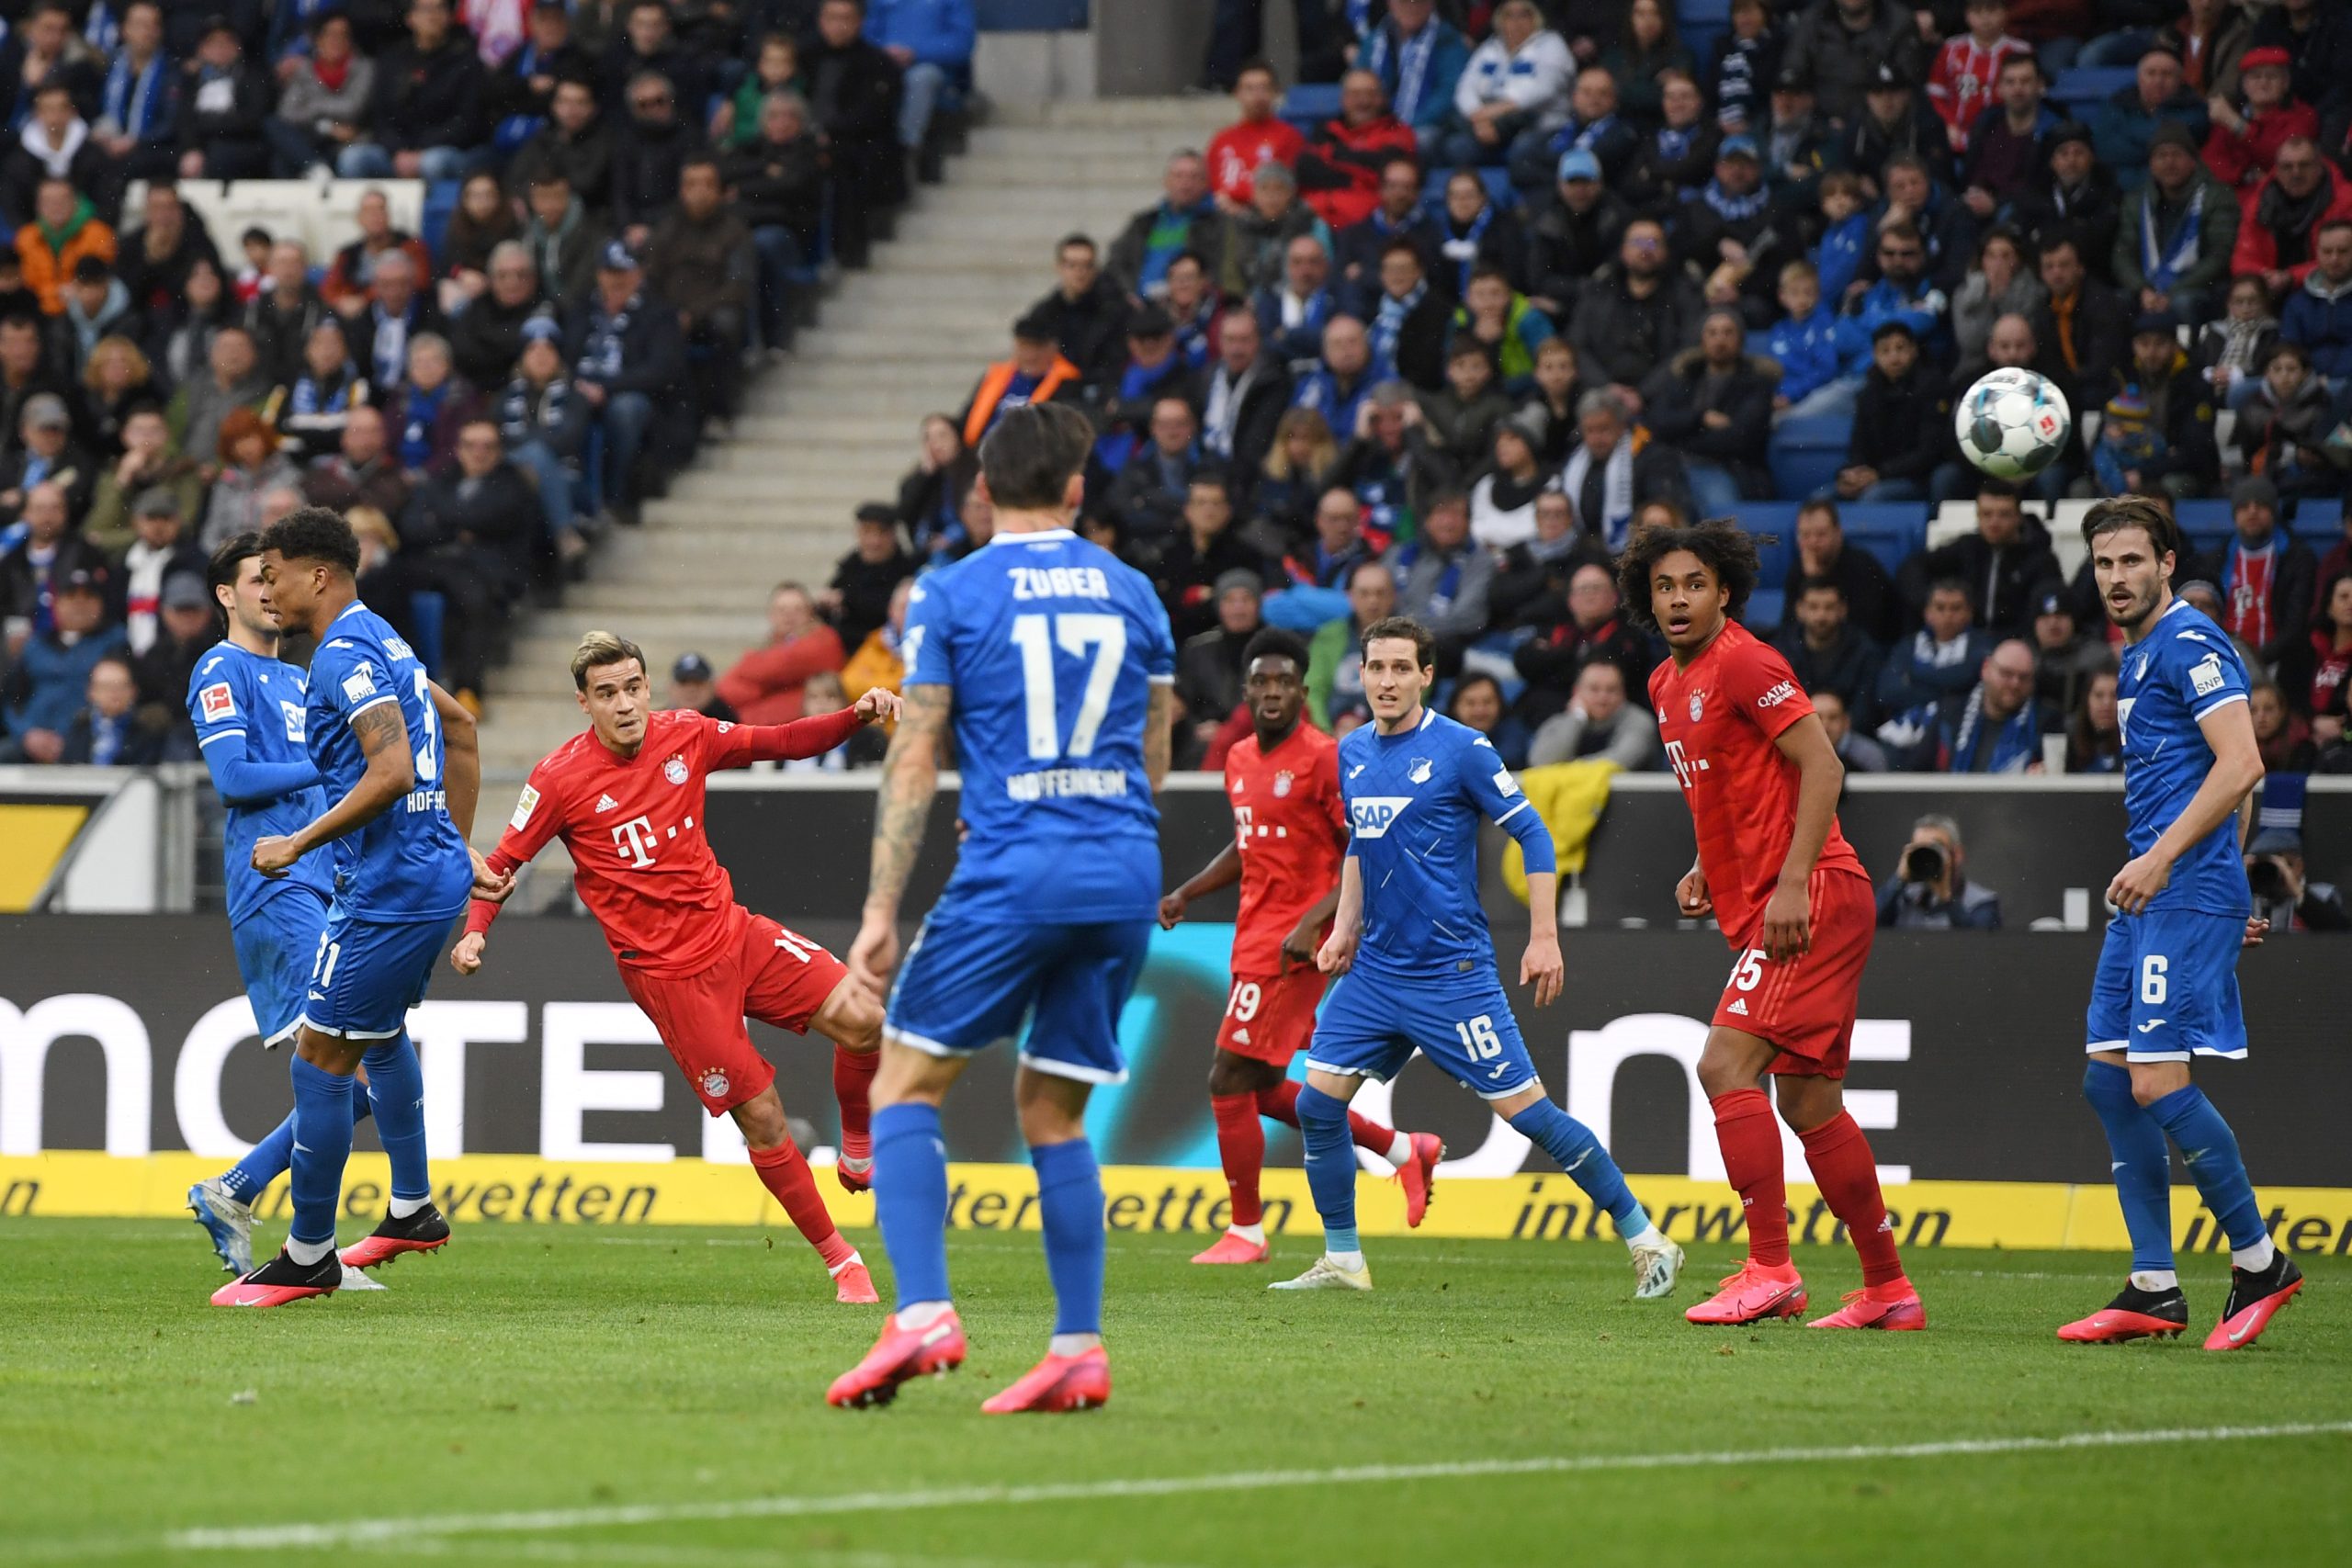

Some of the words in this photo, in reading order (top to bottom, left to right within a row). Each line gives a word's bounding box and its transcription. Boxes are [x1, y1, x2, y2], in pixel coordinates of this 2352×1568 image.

[1007, 567, 1110, 600] ZUBER
[352, 685, 373, 702] SNP
[1010, 613, 1126, 759] 17
[1758, 680, 1792, 707] QATAR
[2197, 676, 2222, 694] SNP
[1353, 805, 1394, 829] SAP
[2141, 954, 2167, 1004] 6
[1227, 980, 1261, 1022] 19
[1455, 1014, 1503, 1063] 16
